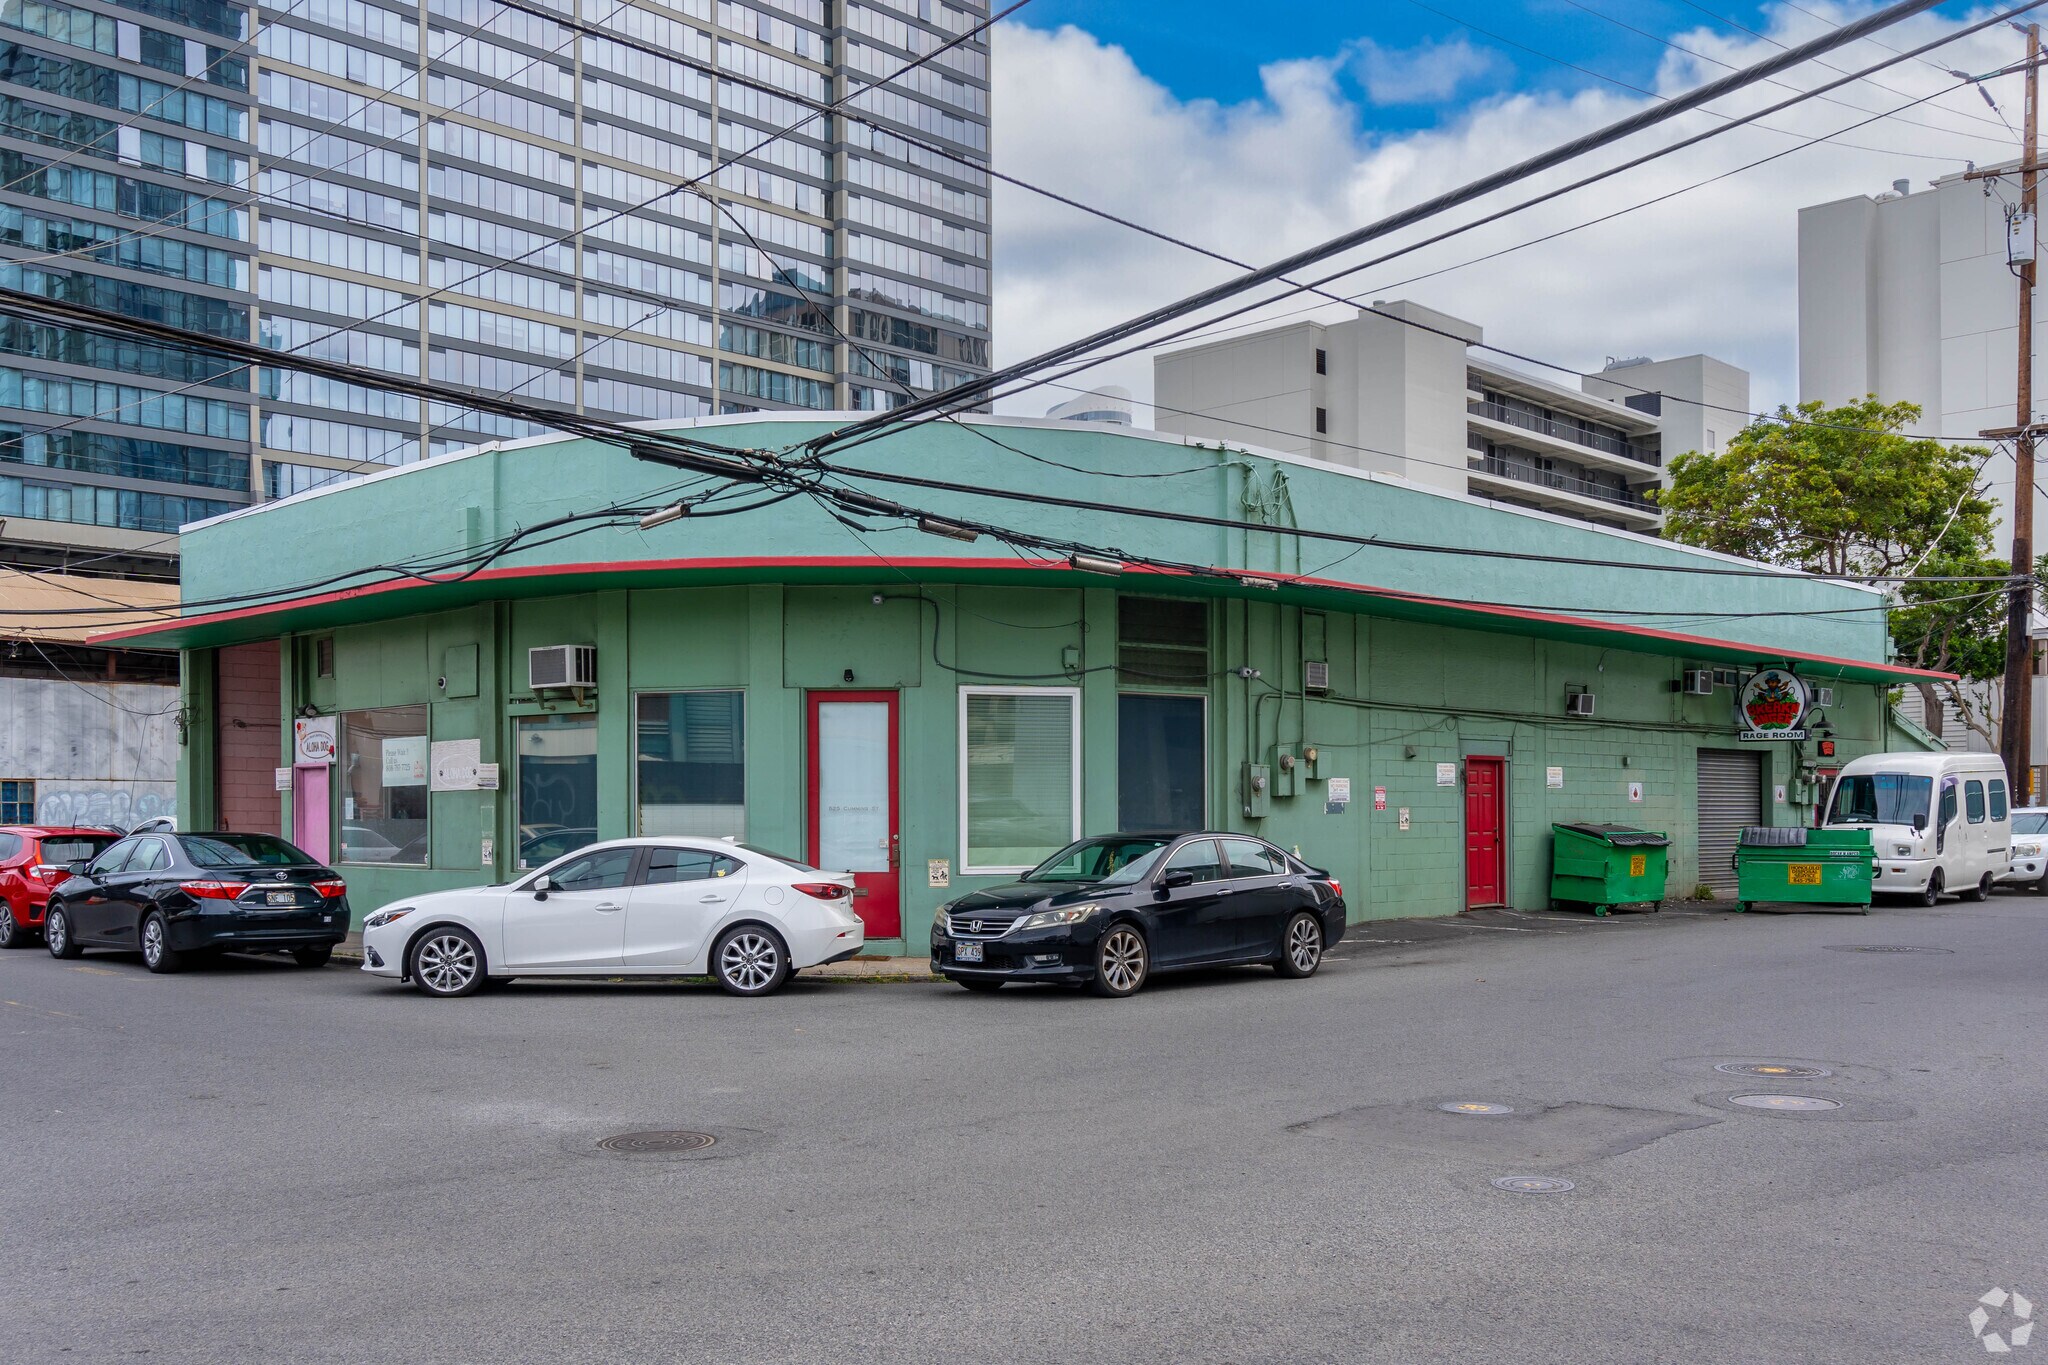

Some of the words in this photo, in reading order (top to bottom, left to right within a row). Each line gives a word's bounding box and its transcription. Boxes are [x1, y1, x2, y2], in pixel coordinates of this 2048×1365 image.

[306, 741, 320, 752] ALOHA
[320, 740, 330, 751] DOG
[443, 767, 461, 779] ALOHA
[970, 947, 981, 957] 439
